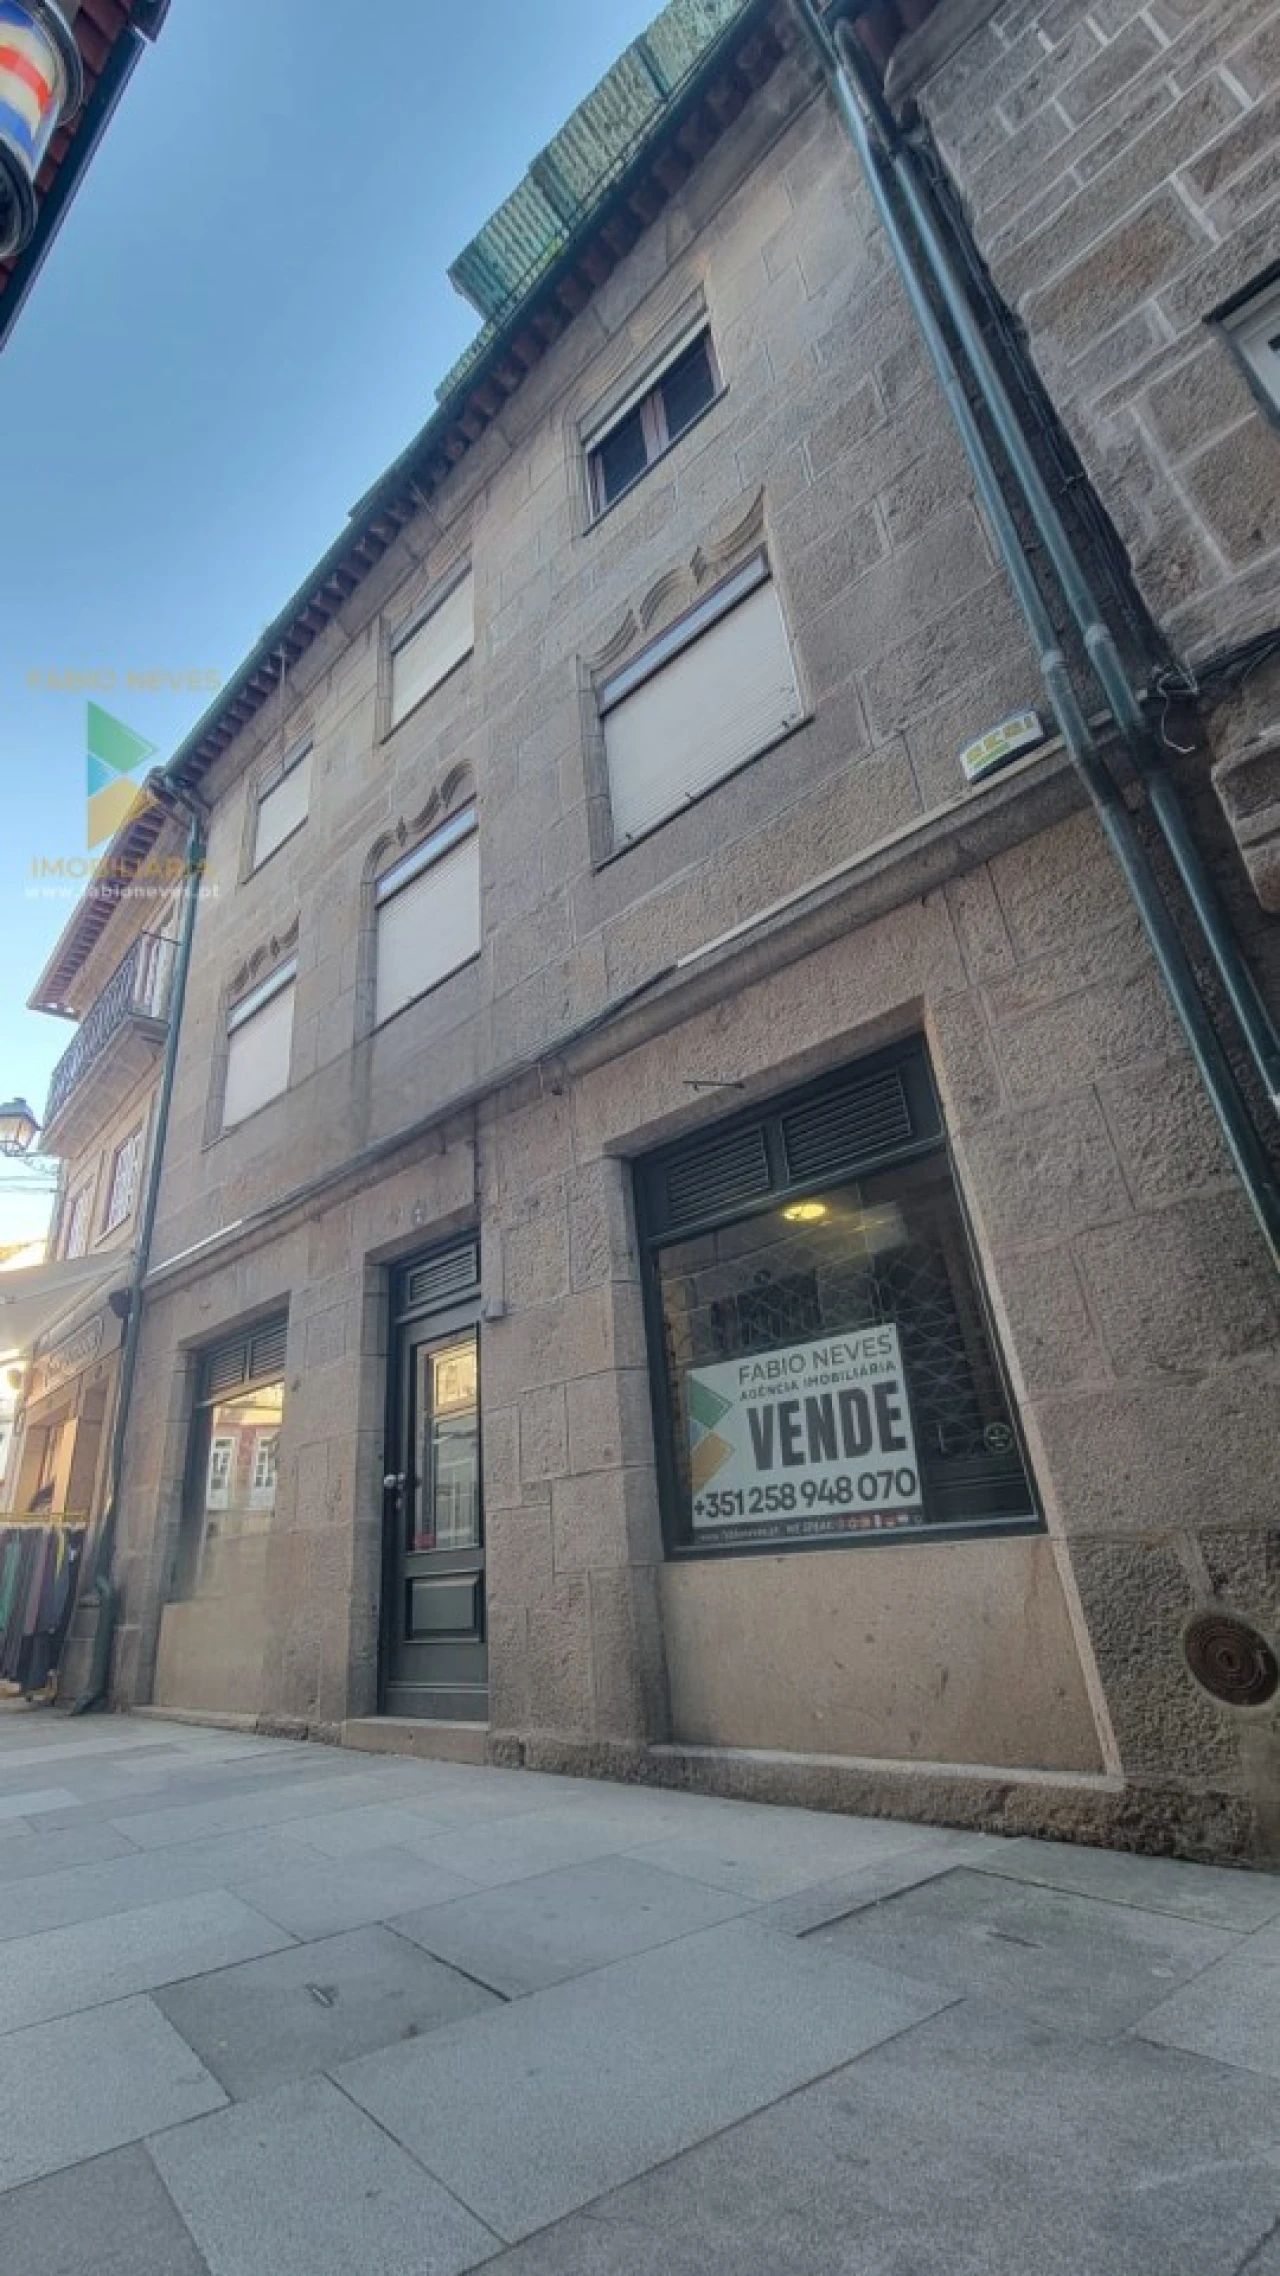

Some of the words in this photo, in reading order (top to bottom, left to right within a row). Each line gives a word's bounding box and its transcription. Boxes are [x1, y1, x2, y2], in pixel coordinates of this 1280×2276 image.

[812, 1334, 893, 1369] NEVES
[747, 1380, 907, 1470] VENDE
[694, 1490, 745, 1518] +351
[748, 1482, 798, 1514] 258
[800, 1475, 854, 1509] 948
[858, 1467, 916, 1501] 070
